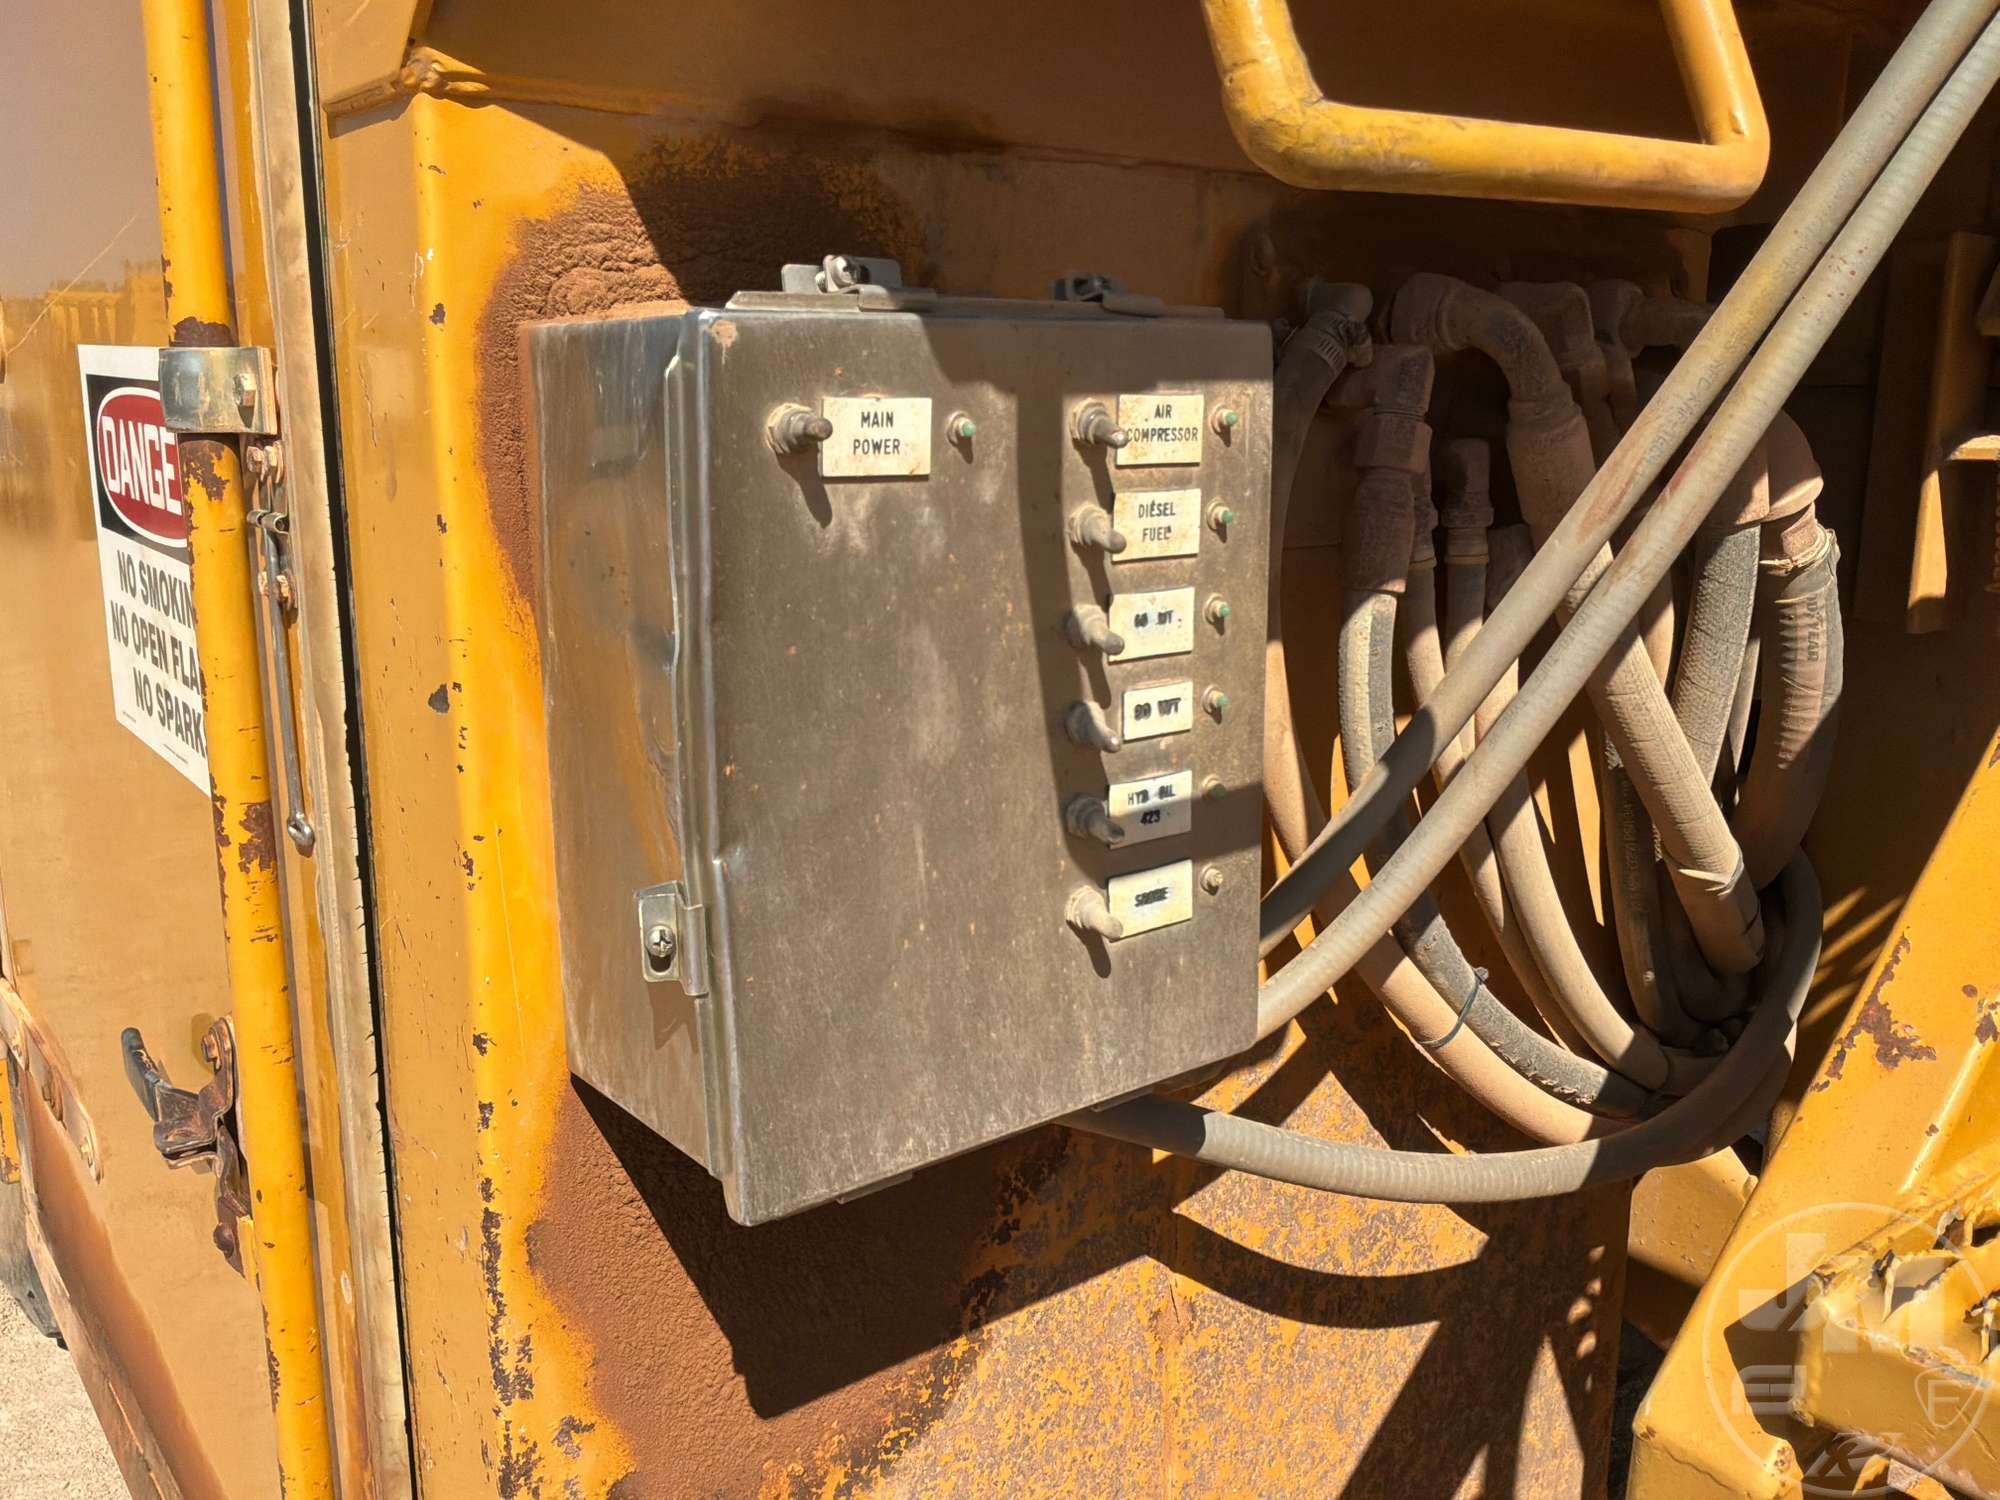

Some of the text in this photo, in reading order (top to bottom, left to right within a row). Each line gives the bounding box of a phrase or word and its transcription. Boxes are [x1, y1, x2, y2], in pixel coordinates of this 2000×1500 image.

[861, 411, 895, 428] MAIN
[1153, 404, 1173, 419] AIR
[1126, 427, 1199, 443] COMPRESSOR
[853, 439, 901, 456] POWER
[102, 415, 183, 517] DANGE
[1142, 526, 1172, 543] FUEL
[117, 549, 196, 630] NO SMOKIN
[111, 600, 200, 697] NO OPEN FLA
[133, 665, 206, 759] NO SPARK
